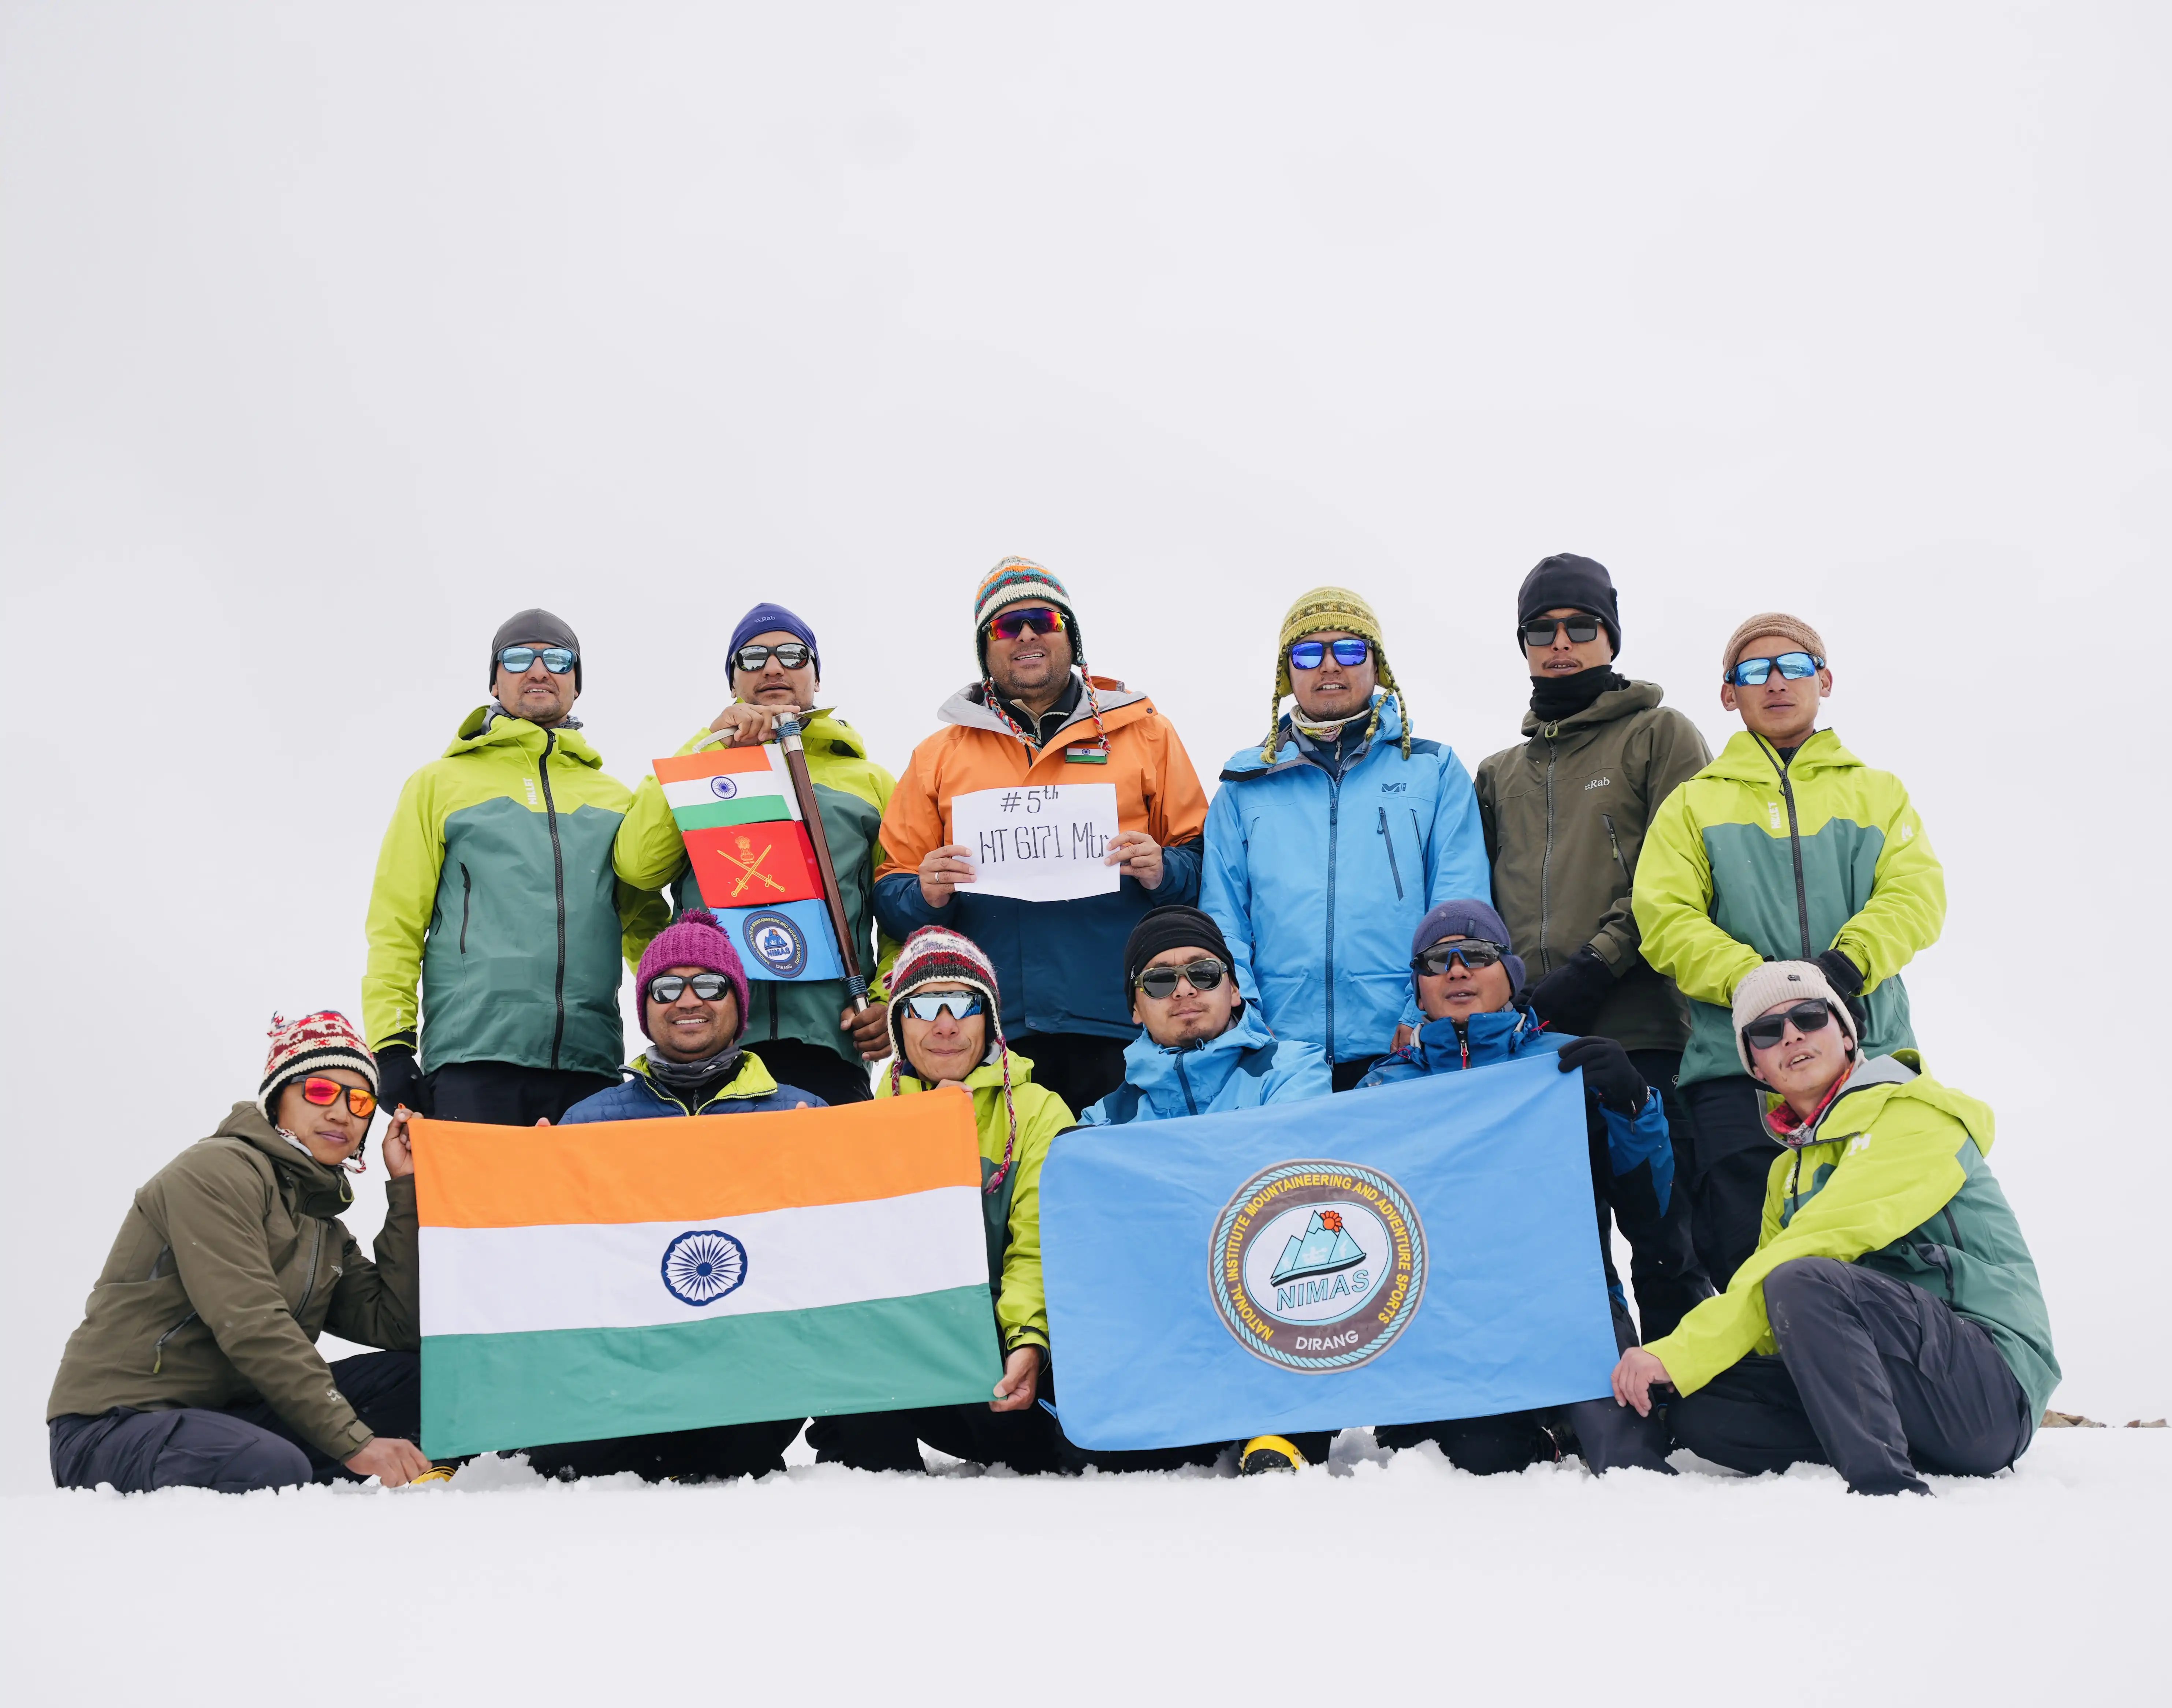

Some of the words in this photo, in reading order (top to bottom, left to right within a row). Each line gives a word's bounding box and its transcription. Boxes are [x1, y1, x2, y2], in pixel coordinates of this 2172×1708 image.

[523, 777, 538, 805] MILLET
[1590, 777, 1610, 790] Rab
[1767, 802, 1781, 829] MILLET
[980, 829, 1007, 864] HT
[1015, 825, 1063, 859] 6171
[751, 918, 780, 927] MOUNTAINEERING
[787, 928, 801, 950] ADVENTURE
[766, 947, 790, 957] NIMAS
[1245, 1174, 1352, 1217] MOUNTAINEERING
[1352, 1182, 1378, 1201] AND
[1226, 1215, 1250, 1282] INSTITUTE
[1375, 1198, 1411, 1271] ADVENTURE
[1277, 1269, 1369, 1311] NIMAS
[1378, 1274, 1409, 1324] SPORTS
[1231, 1284, 1274, 1341] NATIONAL
[1296, 1330, 1359, 1351] DIRANG
